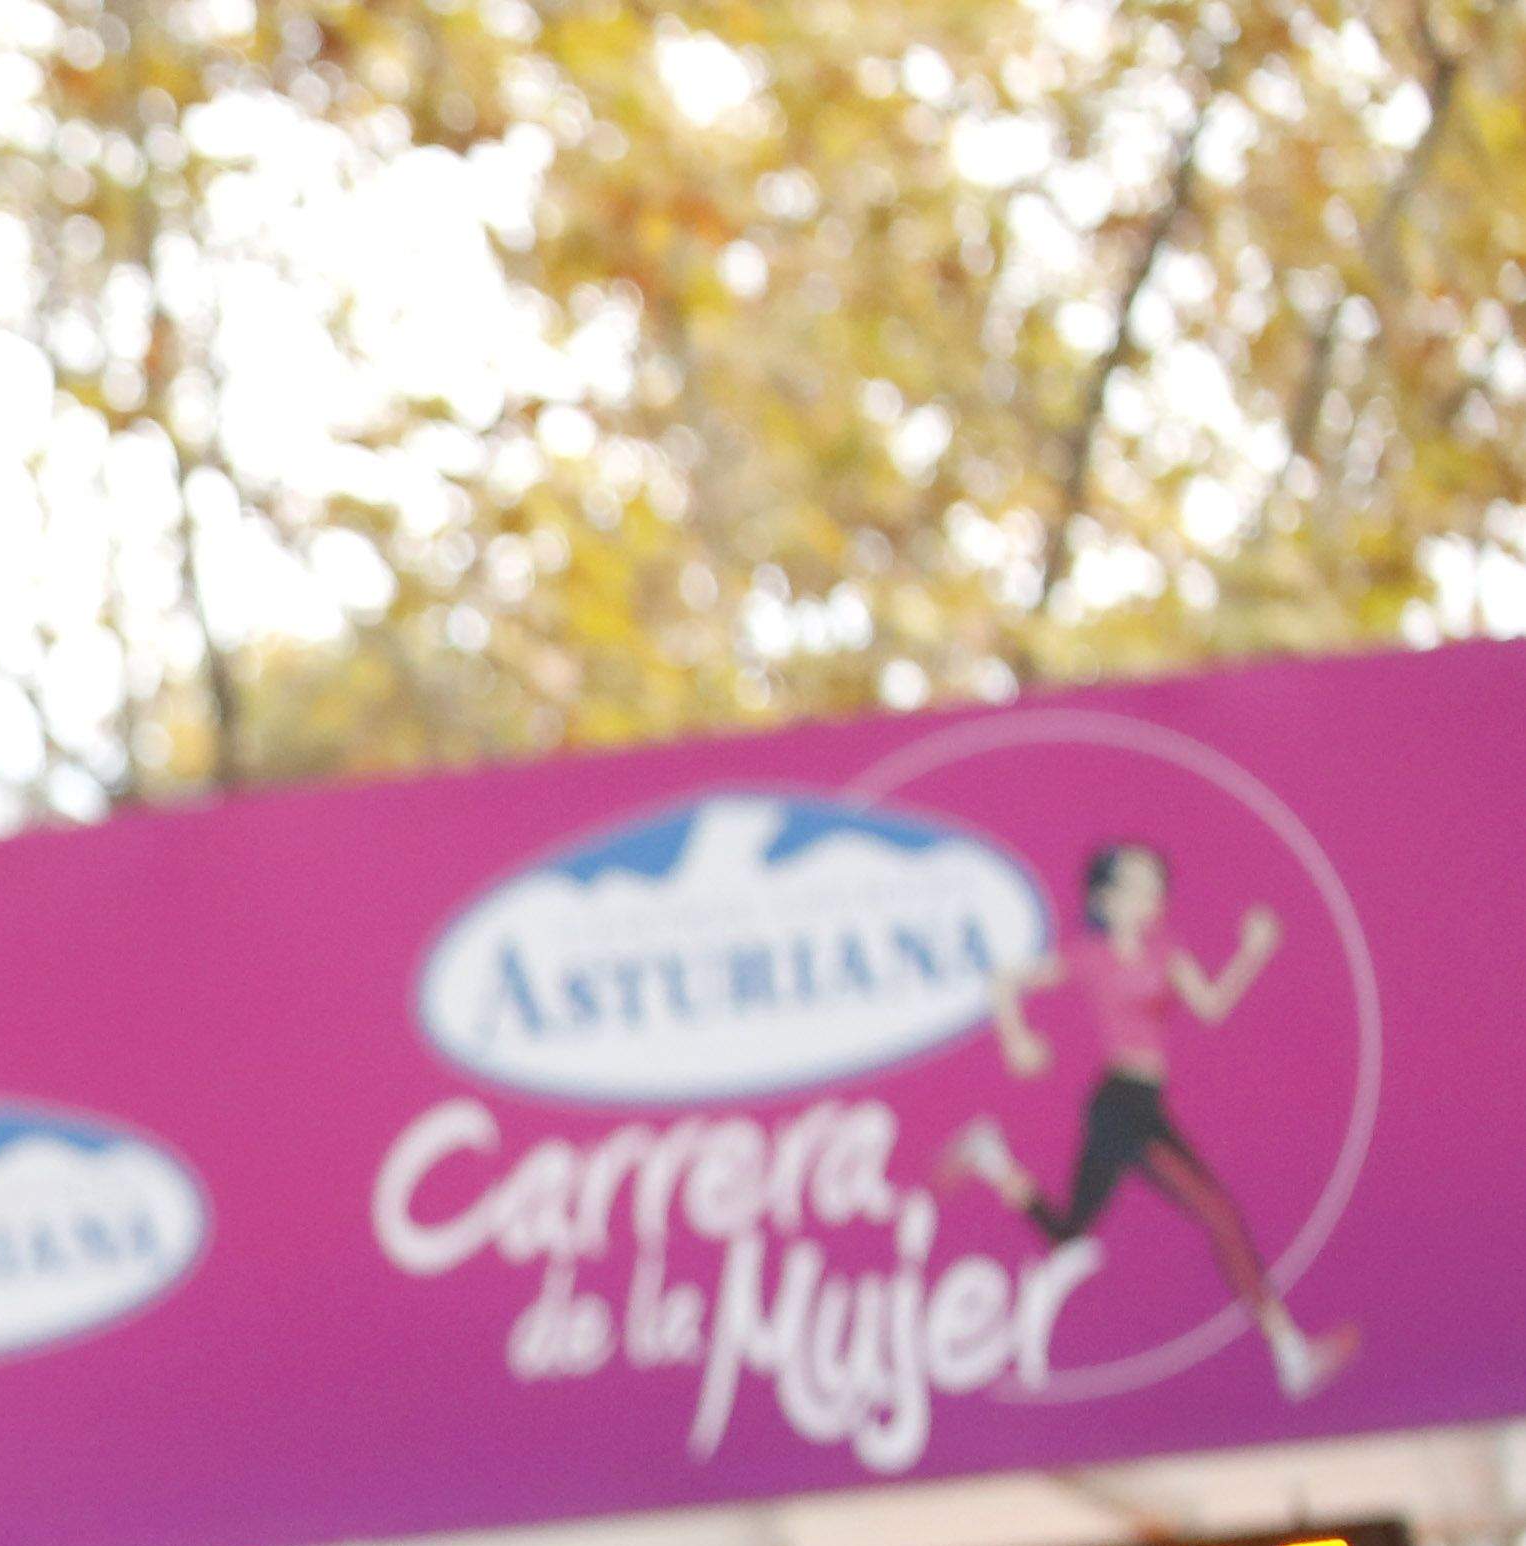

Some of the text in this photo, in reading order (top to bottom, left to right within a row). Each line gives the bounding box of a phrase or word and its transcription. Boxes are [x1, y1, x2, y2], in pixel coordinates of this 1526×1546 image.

[478, 914, 996, 1050] ASTURIANA
[371, 1098, 900, 1272] Carrera
[506, 1192, 1104, 1474] de la Mujer
